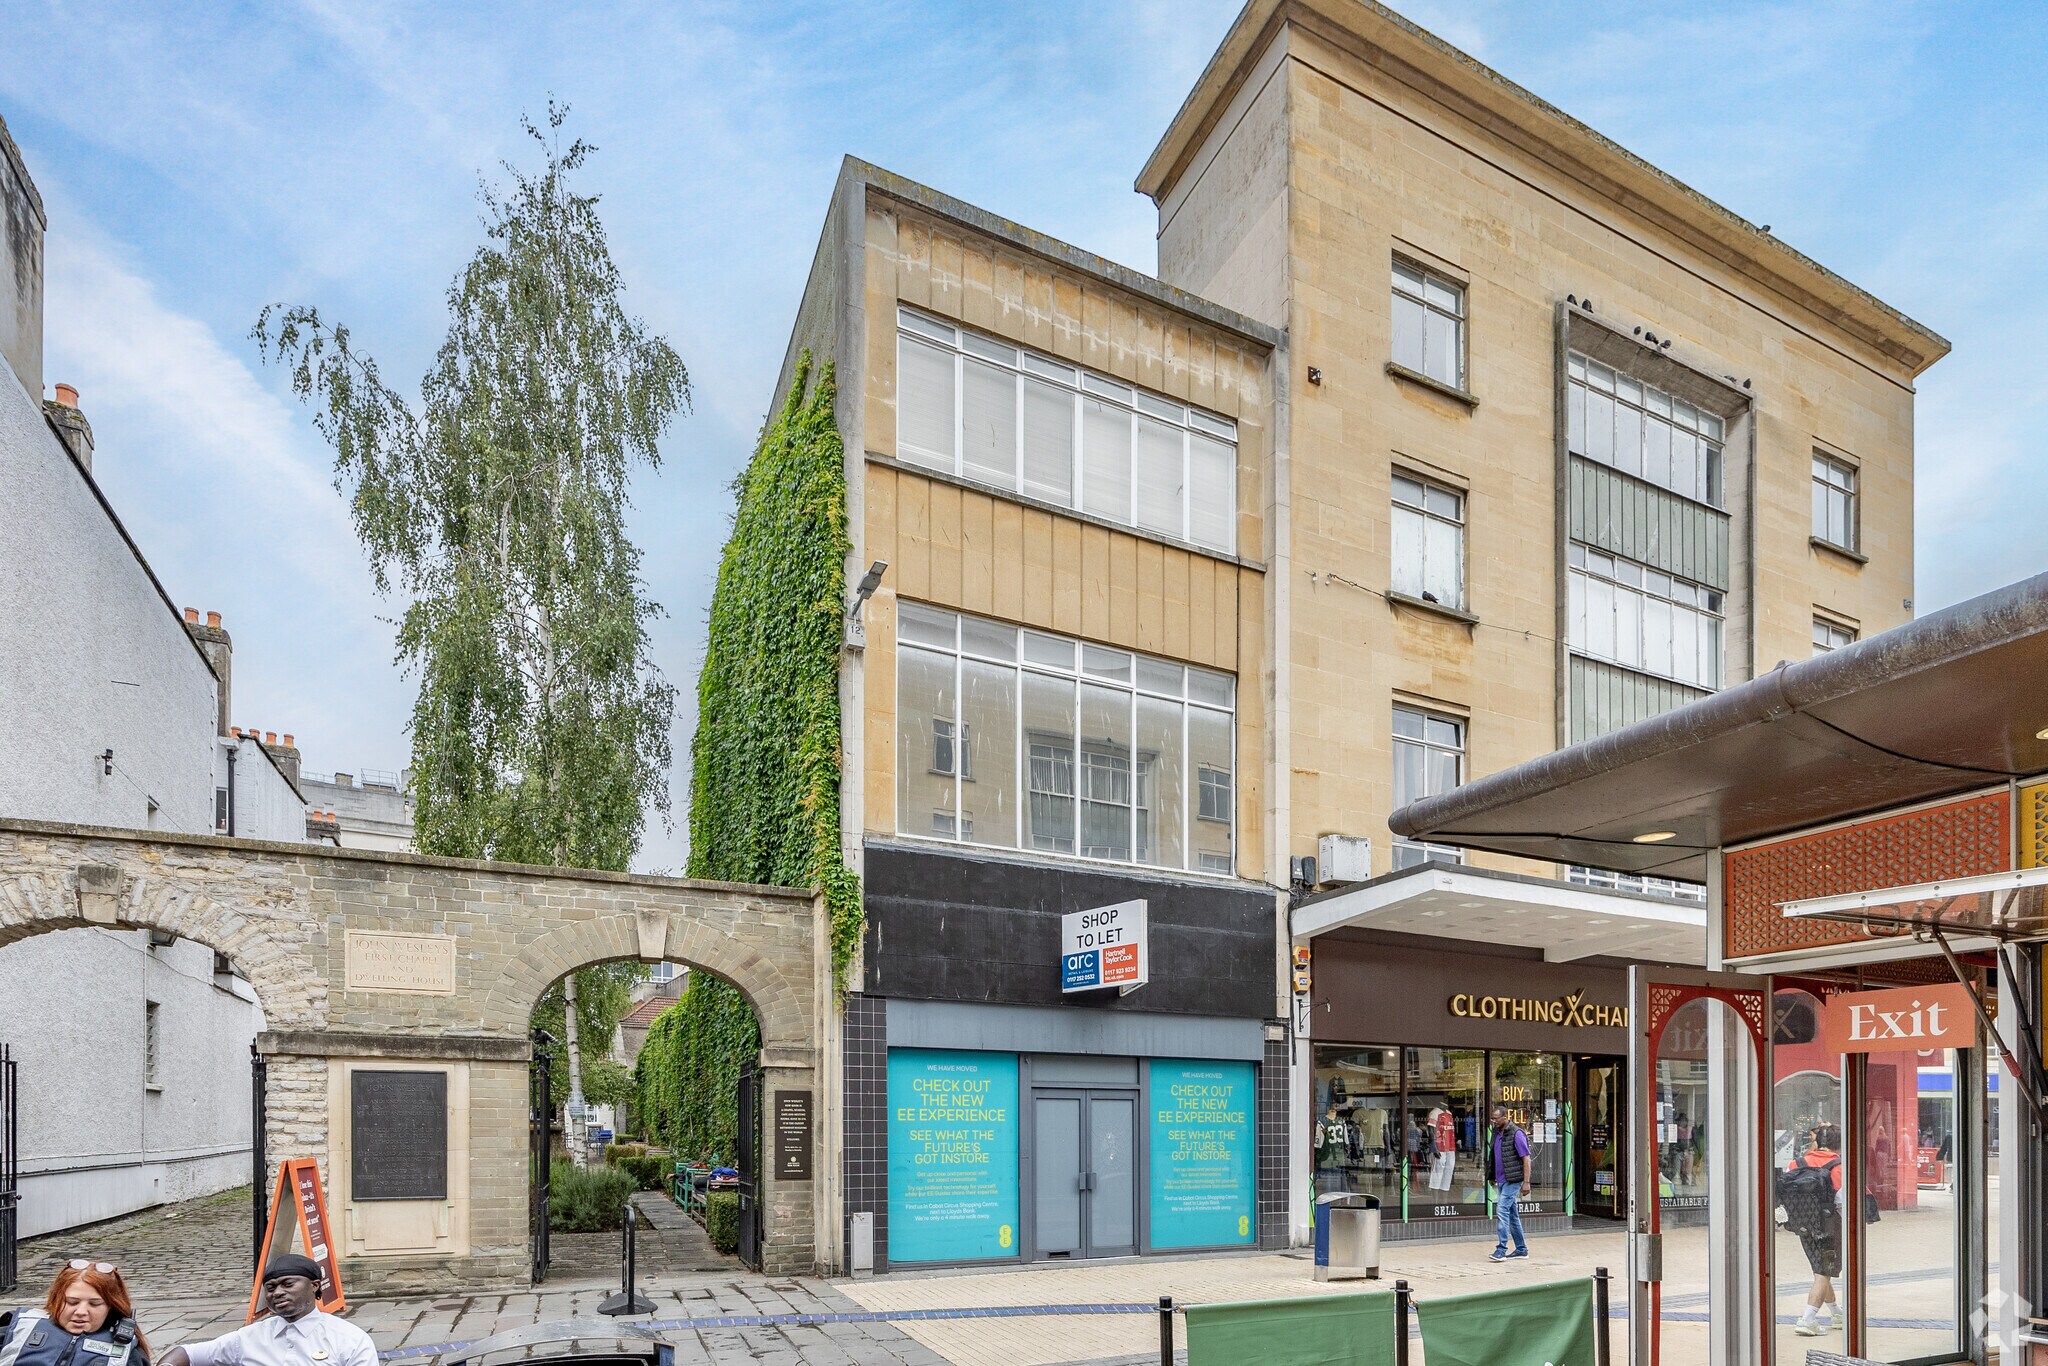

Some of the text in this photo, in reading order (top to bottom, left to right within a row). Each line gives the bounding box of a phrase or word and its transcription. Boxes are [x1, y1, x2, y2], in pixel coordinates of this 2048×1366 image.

[1082, 910, 1118, 929] SHOP
[1076, 928, 1123, 948] TO LET
[355, 940, 388, 951] JOHN
[365, 953, 438, 964] FIRST CHAPEL
[1068, 954, 1093, 970] arc
[412, 977, 445, 985] HOUSE
[1847, 999, 1949, 1041] Exit
[913, 1079, 991, 1092] CHECK OUT
[1171, 1084, 1233, 1096] CHECK OUT
[1503, 1085, 1525, 1102] BUY
[921, 1094, 984, 1107] THE NEW
[1177, 1098, 1228, 1109] THE NEW
[897, 1109, 1006, 1121] EE EXPERIENCE
[1158, 1111, 1245, 1123] EE EXPERIENCE
[910, 1130, 994, 1141] SEE WHAT THE
[1168, 1130, 1236, 1140] SEE WHAT THE
[1327, 1124, 1344, 1144] 33
[925, 1142, 980, 1153] FUTURE'S
[1180, 1142, 1224, 1151] FUTURE'S
[915, 1153, 989, 1164] GOT INSTORE
[1172, 1151, 1231, 1160] GOT INSTORE
[1518, 1203, 1543, 1213] RADE.
[1659, 1197, 1702, 1208] USTAINABLE
[1434, 1205, 1460, 1216] SELL.
